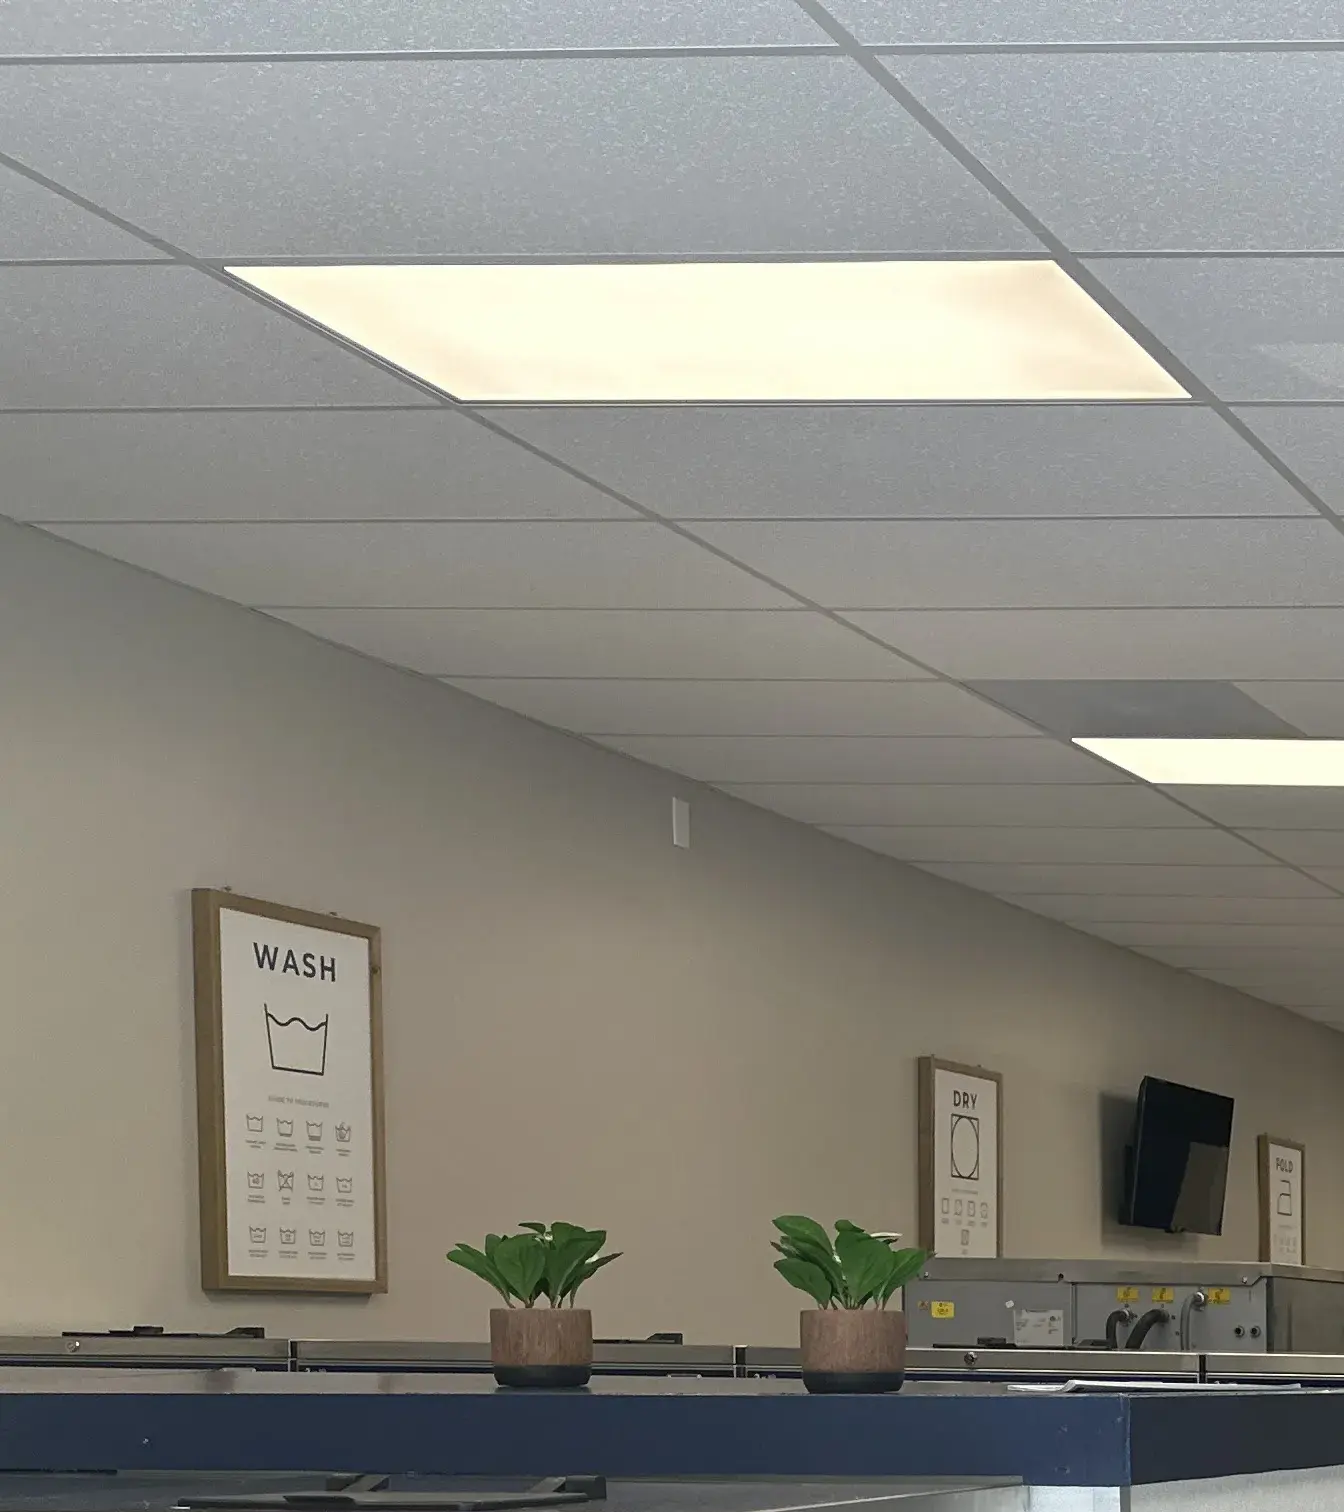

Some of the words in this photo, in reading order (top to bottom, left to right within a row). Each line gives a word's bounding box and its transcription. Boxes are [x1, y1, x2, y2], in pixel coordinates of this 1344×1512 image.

[253, 942, 336, 982] WASH
[953, 1090, 978, 1110] DRY
[1276, 1157, 1293, 1173] FOLD
